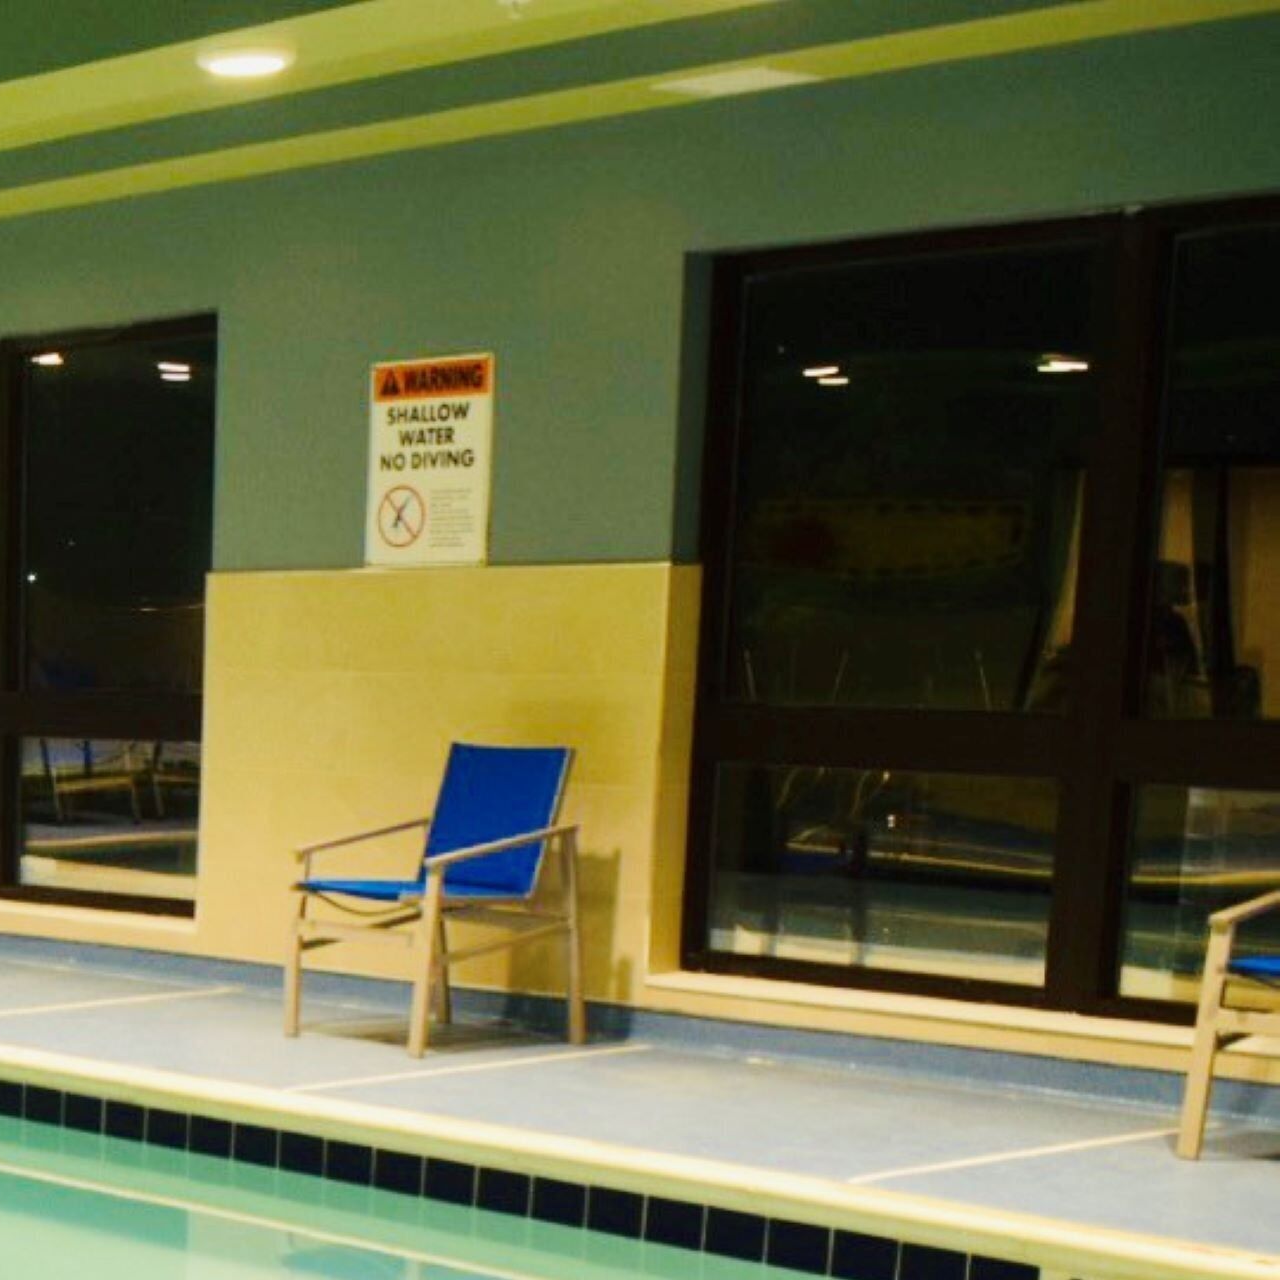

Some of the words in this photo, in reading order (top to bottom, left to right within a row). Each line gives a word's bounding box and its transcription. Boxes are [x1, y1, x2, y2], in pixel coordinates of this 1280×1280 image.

[403, 363, 484, 394] WARNING
[386, 402, 470, 426] SHALLOW
[398, 427, 456, 447] WATER
[379, 452, 406, 473] NO
[410, 449, 475, 472] DIVING
